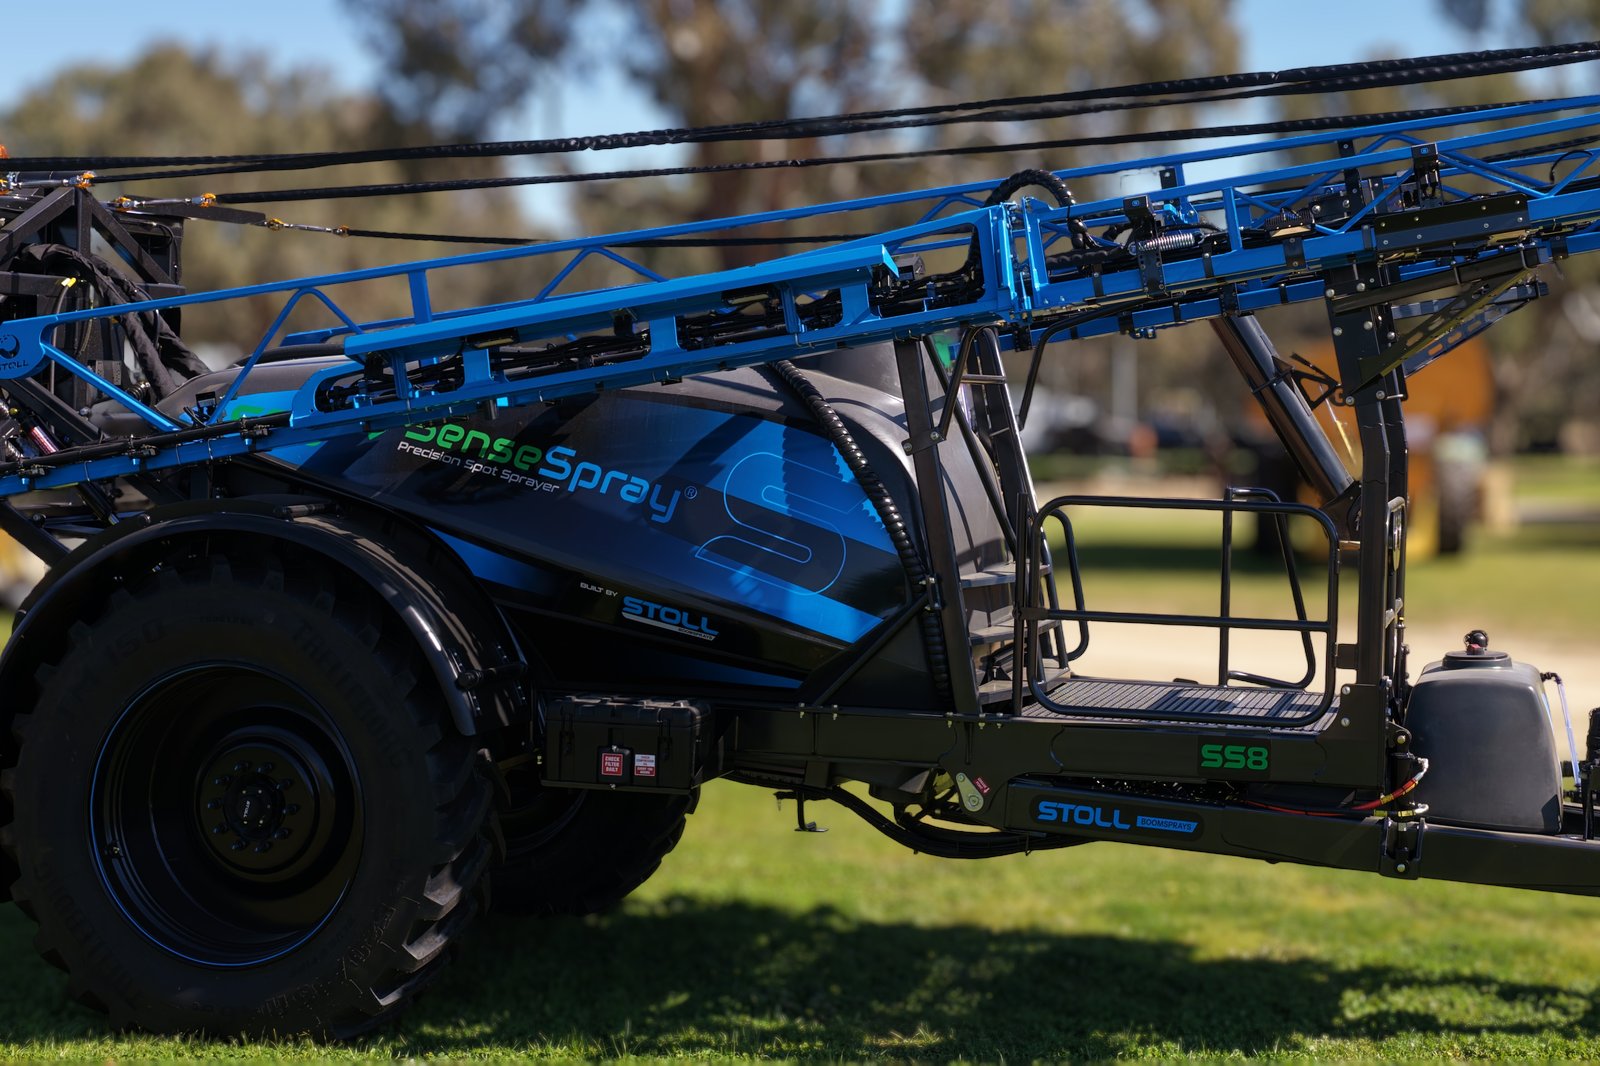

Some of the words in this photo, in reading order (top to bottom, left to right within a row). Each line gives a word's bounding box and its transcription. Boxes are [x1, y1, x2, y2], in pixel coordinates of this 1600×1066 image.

[397, 441, 461, 467] Precision
[464, 458, 499, 477] Spot
[501, 468, 560, 493] Sprayer
[580, 582, 603, 593] BUILT
[606, 589, 618, 597] BY
[623, 596, 720, 635] STOLL
[1200, 744, 1269, 770] SS8
[1038, 801, 1132, 830] STOLL
[1141, 818, 1192, 832] BOOMSPRAYS
